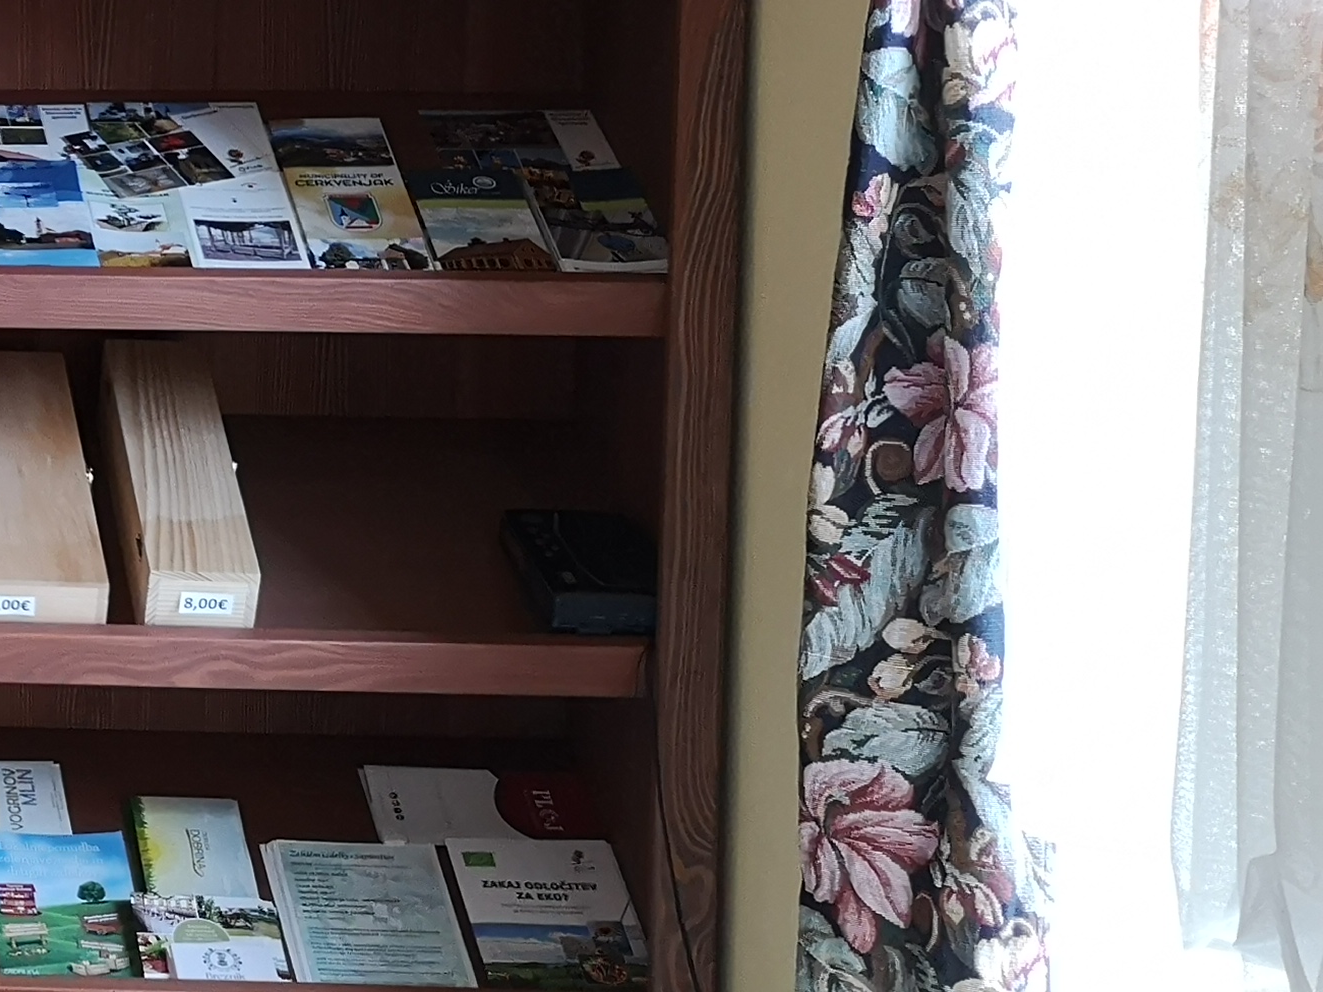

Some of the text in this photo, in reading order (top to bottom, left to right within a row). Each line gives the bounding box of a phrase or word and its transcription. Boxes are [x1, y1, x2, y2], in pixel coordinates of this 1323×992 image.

[295, 179, 395, 187] CERKVENJAK
[183, 596, 229, 611] 8,00€
[16, 769, 38, 806] MLIN
[481, 880, 598, 891] ZAKAJ ODLOČITEV
[516, 892, 570, 901] ZA EKO?
